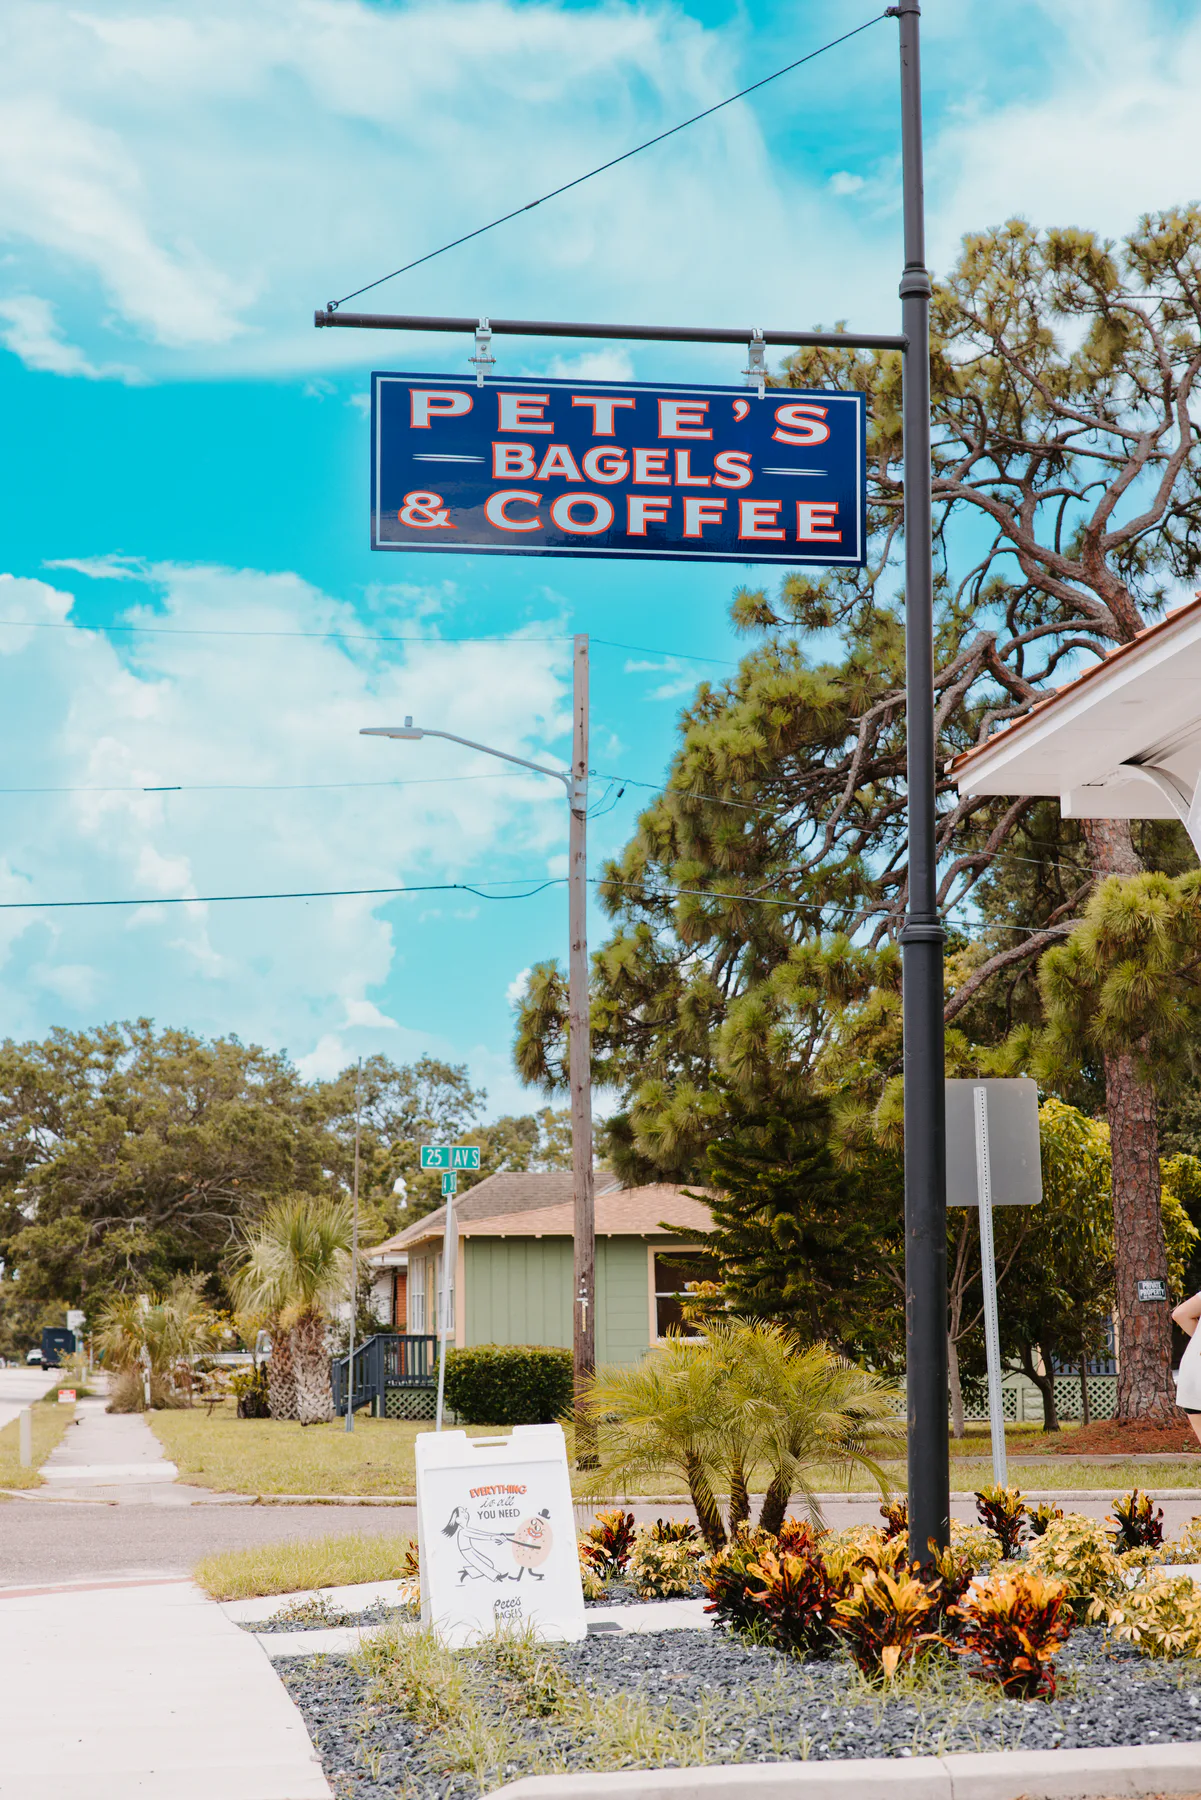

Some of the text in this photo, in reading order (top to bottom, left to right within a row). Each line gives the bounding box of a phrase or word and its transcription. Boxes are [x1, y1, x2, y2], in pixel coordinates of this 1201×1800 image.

[408, 388, 830, 446] PETE'S
[491, 441, 753, 490] BAGELS
[399, 489, 842, 543] & COFFEE
[426, 1149, 479, 1167] 25 AV S
[1140, 1289, 1164, 1297] PROPERTY
[1142, 1282, 1161, 1290] PRIVATE
[469, 1484, 527, 1499] EVERYTHING
[477, 1508, 520, 1520] YOU NEED
[493, 1596, 522, 1609] Pete's
